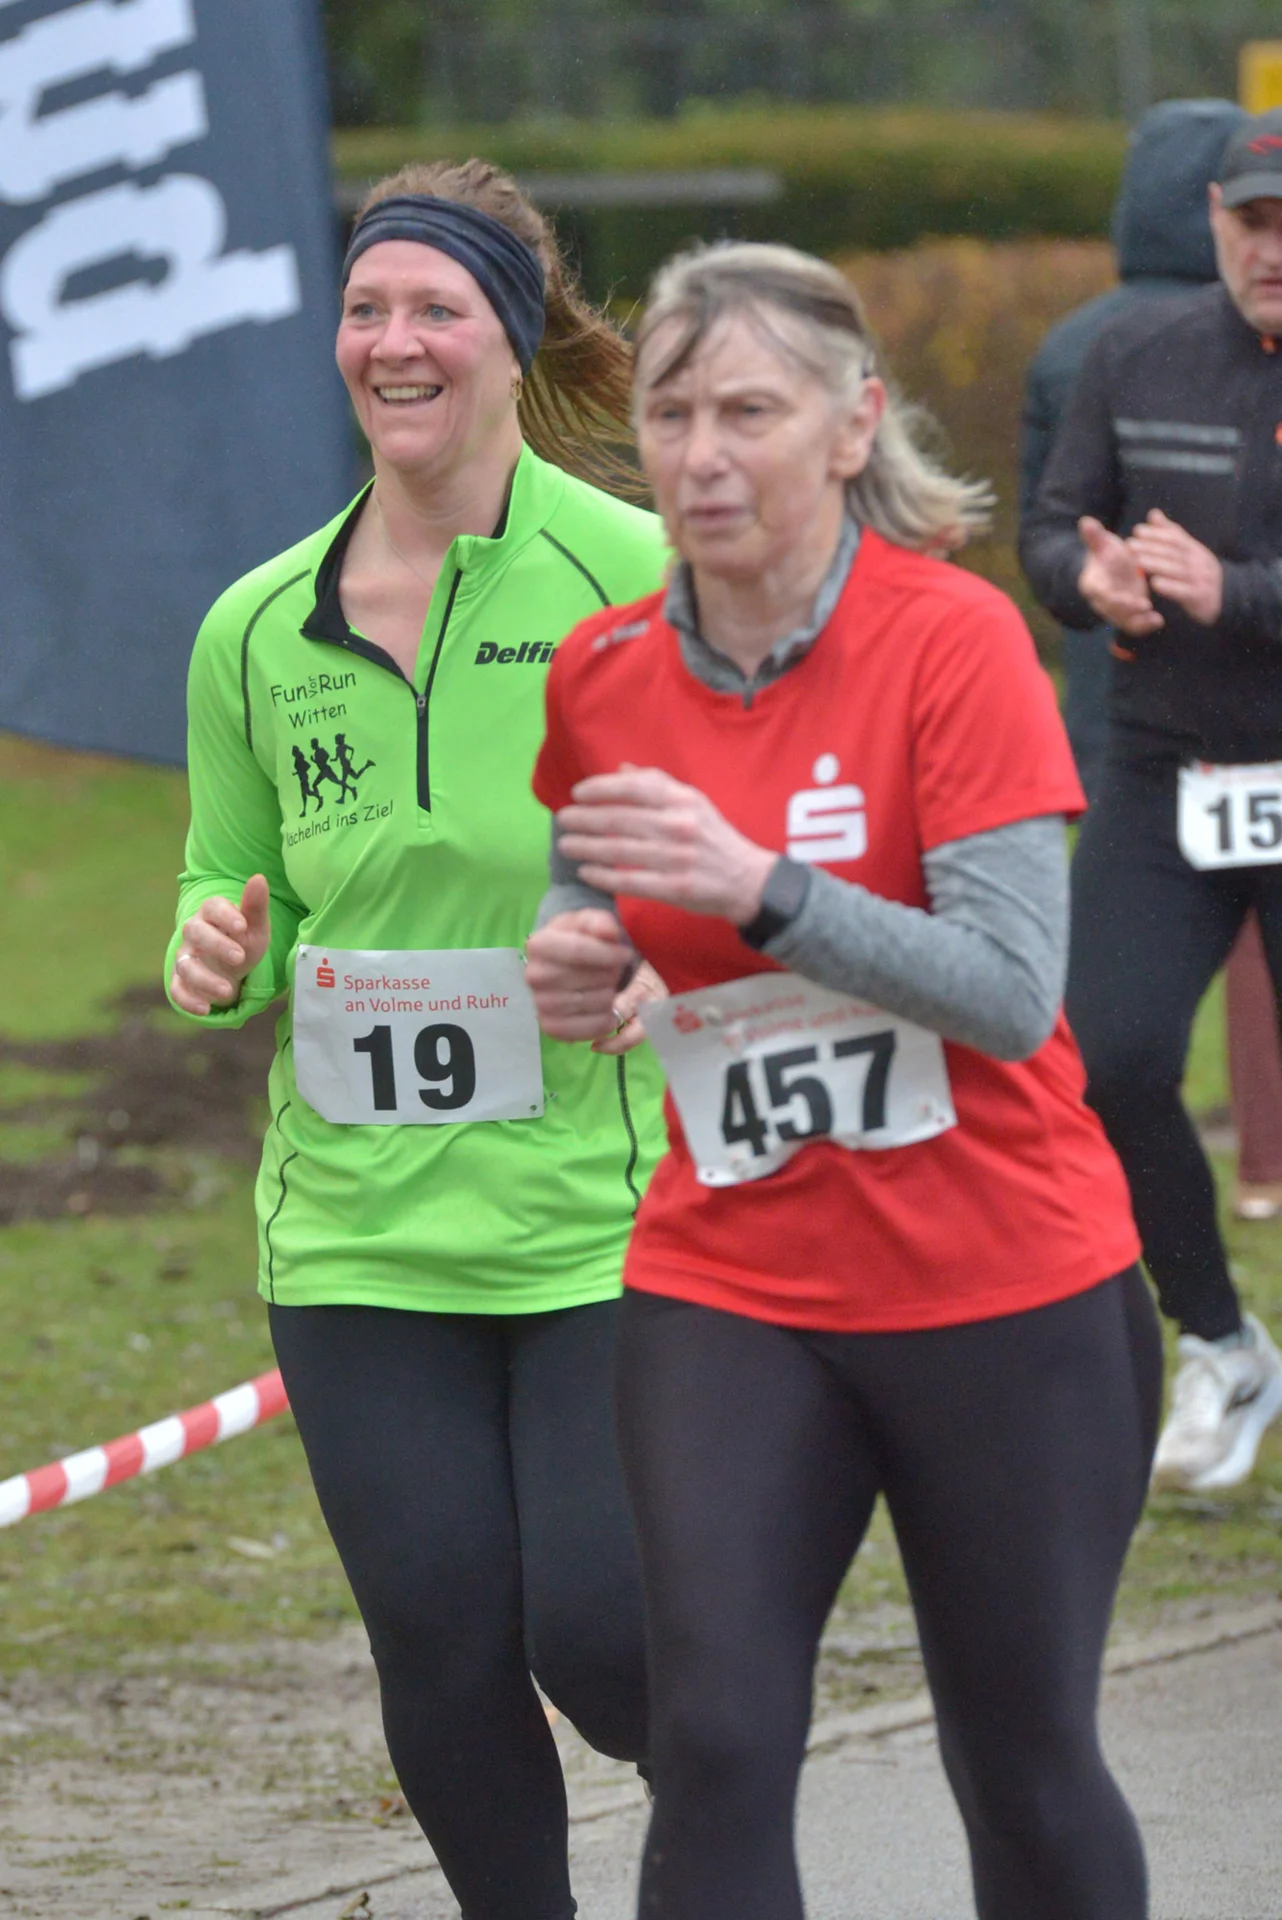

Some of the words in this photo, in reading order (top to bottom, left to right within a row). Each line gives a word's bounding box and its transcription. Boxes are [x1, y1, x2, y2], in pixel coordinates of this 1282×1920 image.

[270, 684, 307, 708] Fun
[318, 672, 357, 694] Run
[288, 703, 347, 729] Witten
[336, 812, 358, 829] ins
[363, 799, 393, 822] Ziel
[343, 975, 431, 993] Sparkasse
[345, 998, 365, 1013] an
[370, 997, 423, 1013] Volme
[428, 995, 461, 1011] und
[467, 993, 509, 1009] Ruhr
[353, 1022, 476, 1111] 19
[721, 1029, 896, 1157] 457
